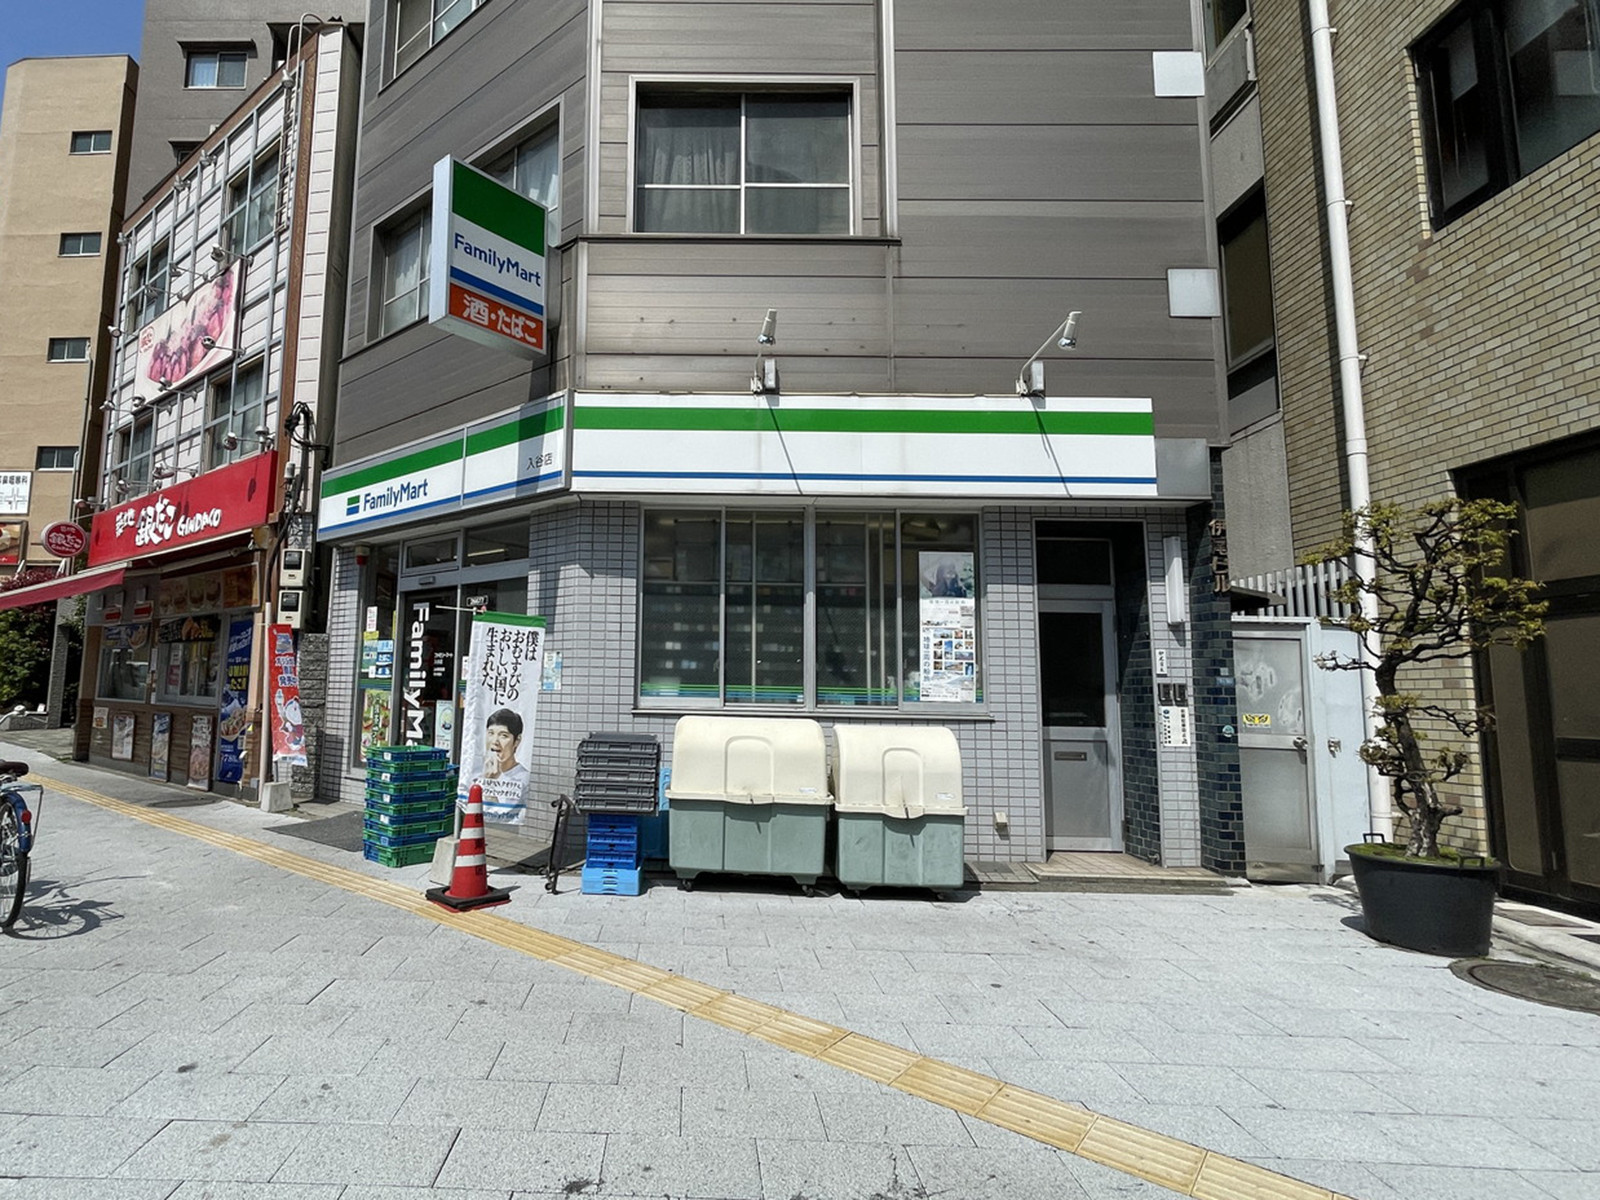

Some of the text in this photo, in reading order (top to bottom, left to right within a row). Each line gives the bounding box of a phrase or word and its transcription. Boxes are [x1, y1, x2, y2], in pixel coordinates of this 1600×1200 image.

[454, 232, 541, 287] FamilyMart
[463, 293, 537, 343] 酒・たばこ
[526, 452, 553, 471] 入谷店
[363, 478, 428, 512] FamilyMart
[481, 626, 499, 692] 生まれた。
[494, 628, 513, 706] おいしい国に
[506, 629, 526, 701] おむすびの
[525, 630, 539, 661] 僕は
